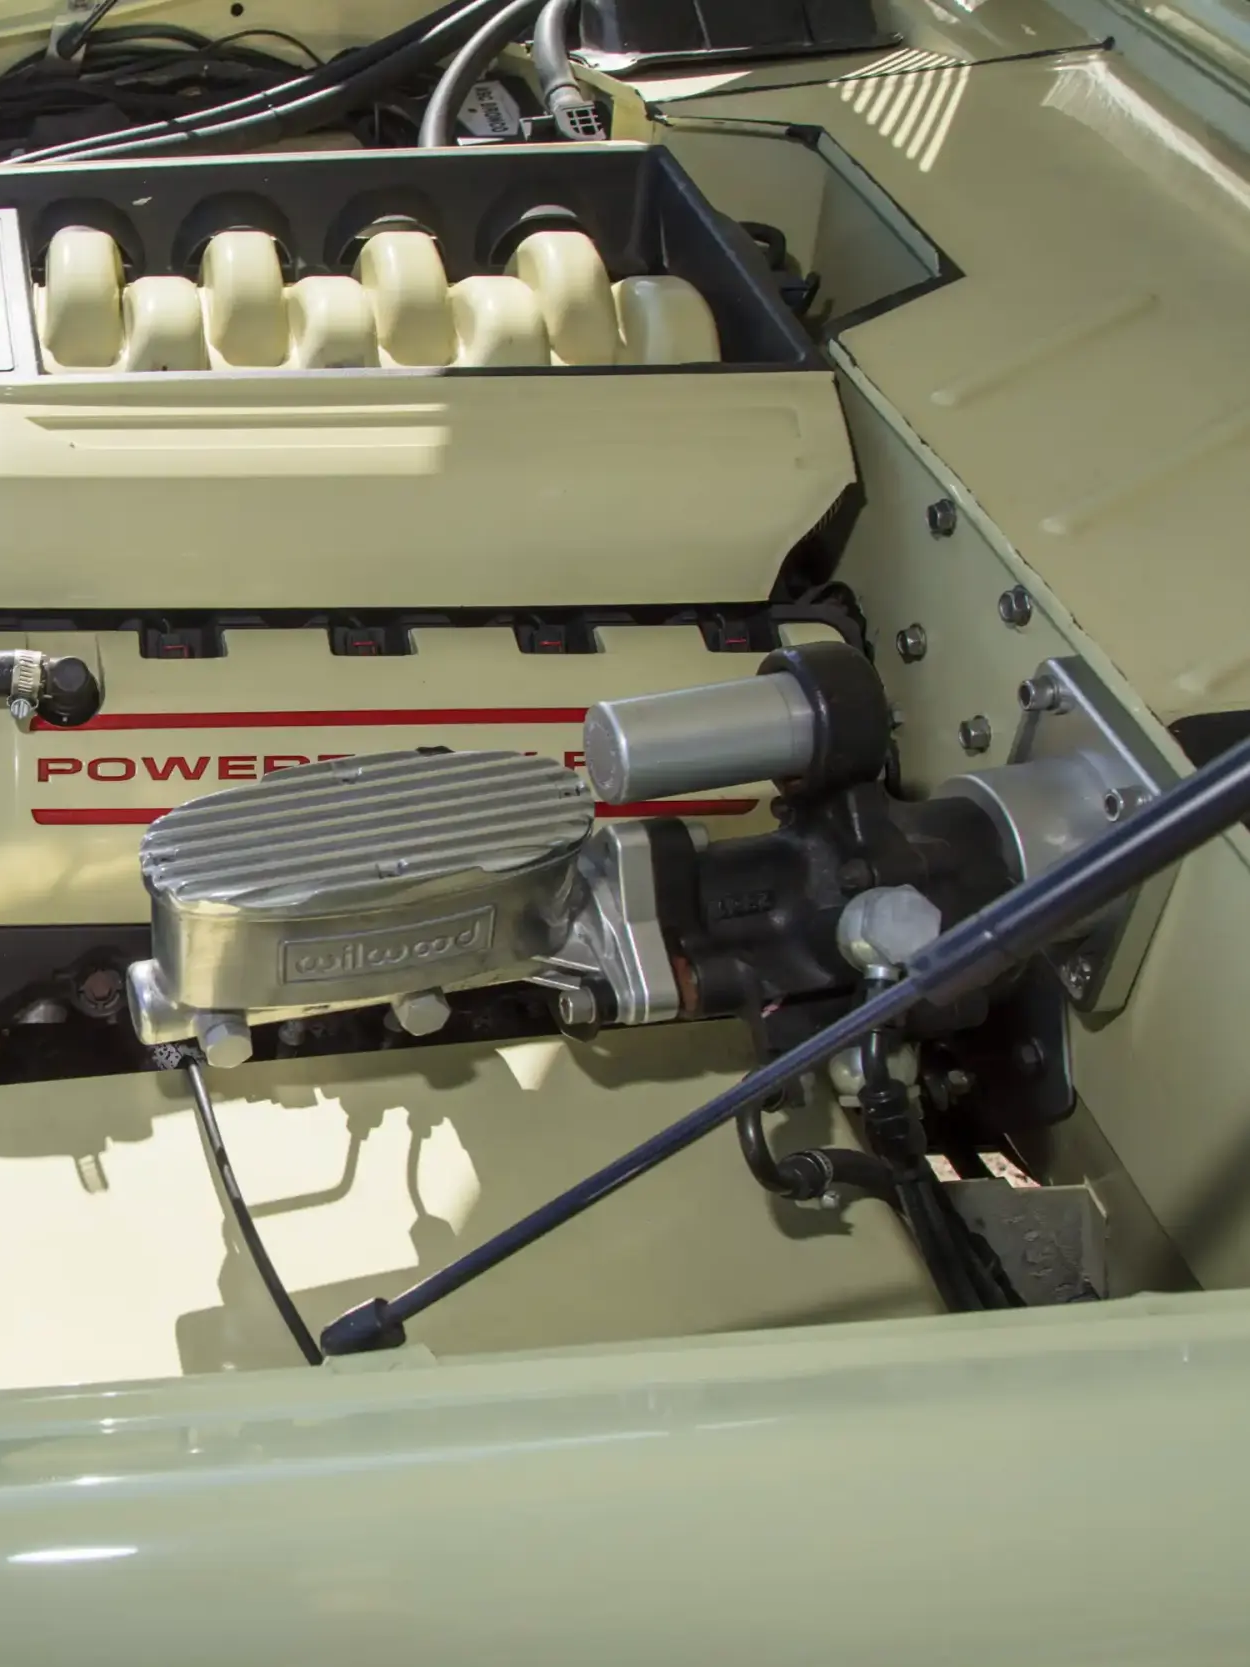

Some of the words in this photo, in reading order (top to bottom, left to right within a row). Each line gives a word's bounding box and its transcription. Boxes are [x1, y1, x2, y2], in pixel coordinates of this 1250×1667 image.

[481, 102, 508, 132] BRONCO
[37, 754, 356, 783] POWE
[294, 919, 482, 975] wilwood
